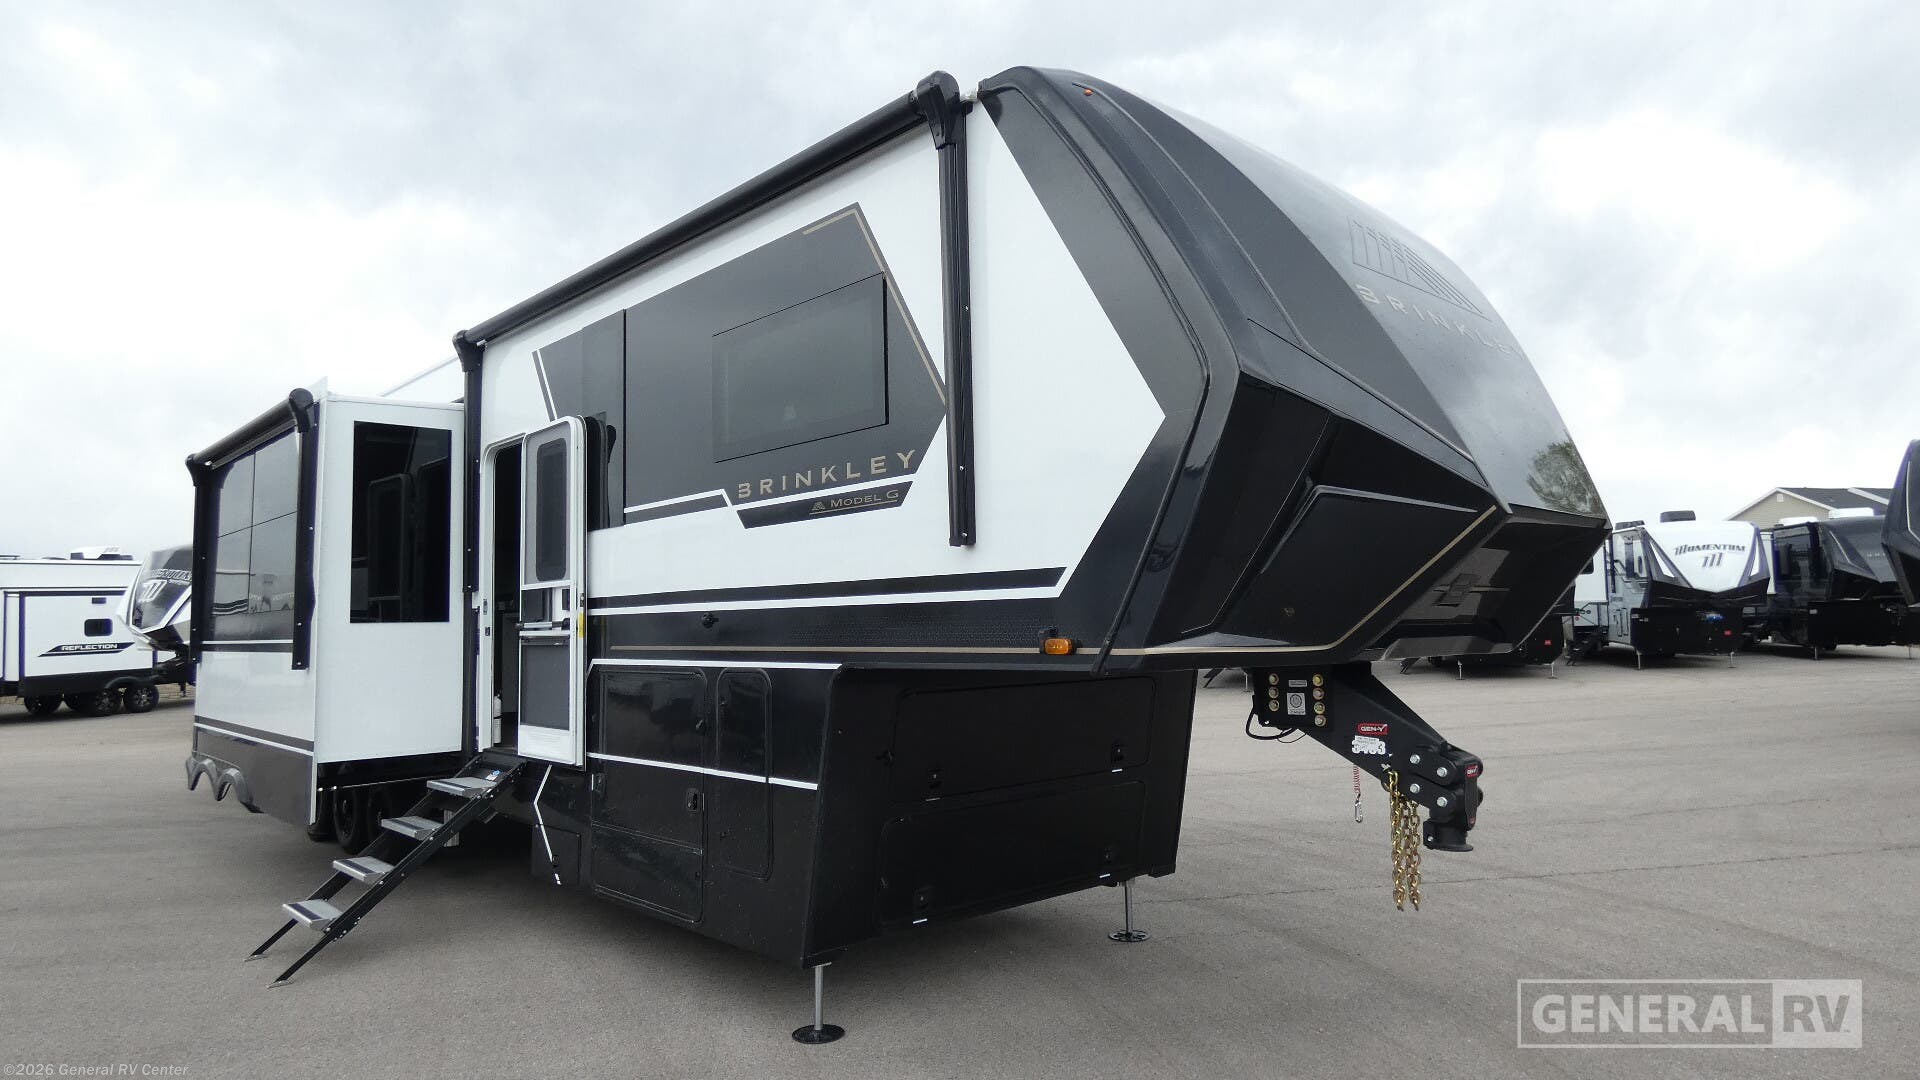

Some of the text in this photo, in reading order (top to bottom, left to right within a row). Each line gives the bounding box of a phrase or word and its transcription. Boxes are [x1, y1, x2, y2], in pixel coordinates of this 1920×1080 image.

[738, 449, 916, 499] BRINKLEY
[886, 489, 900, 499] G
[61, 643, 118, 651] REFLECTION
